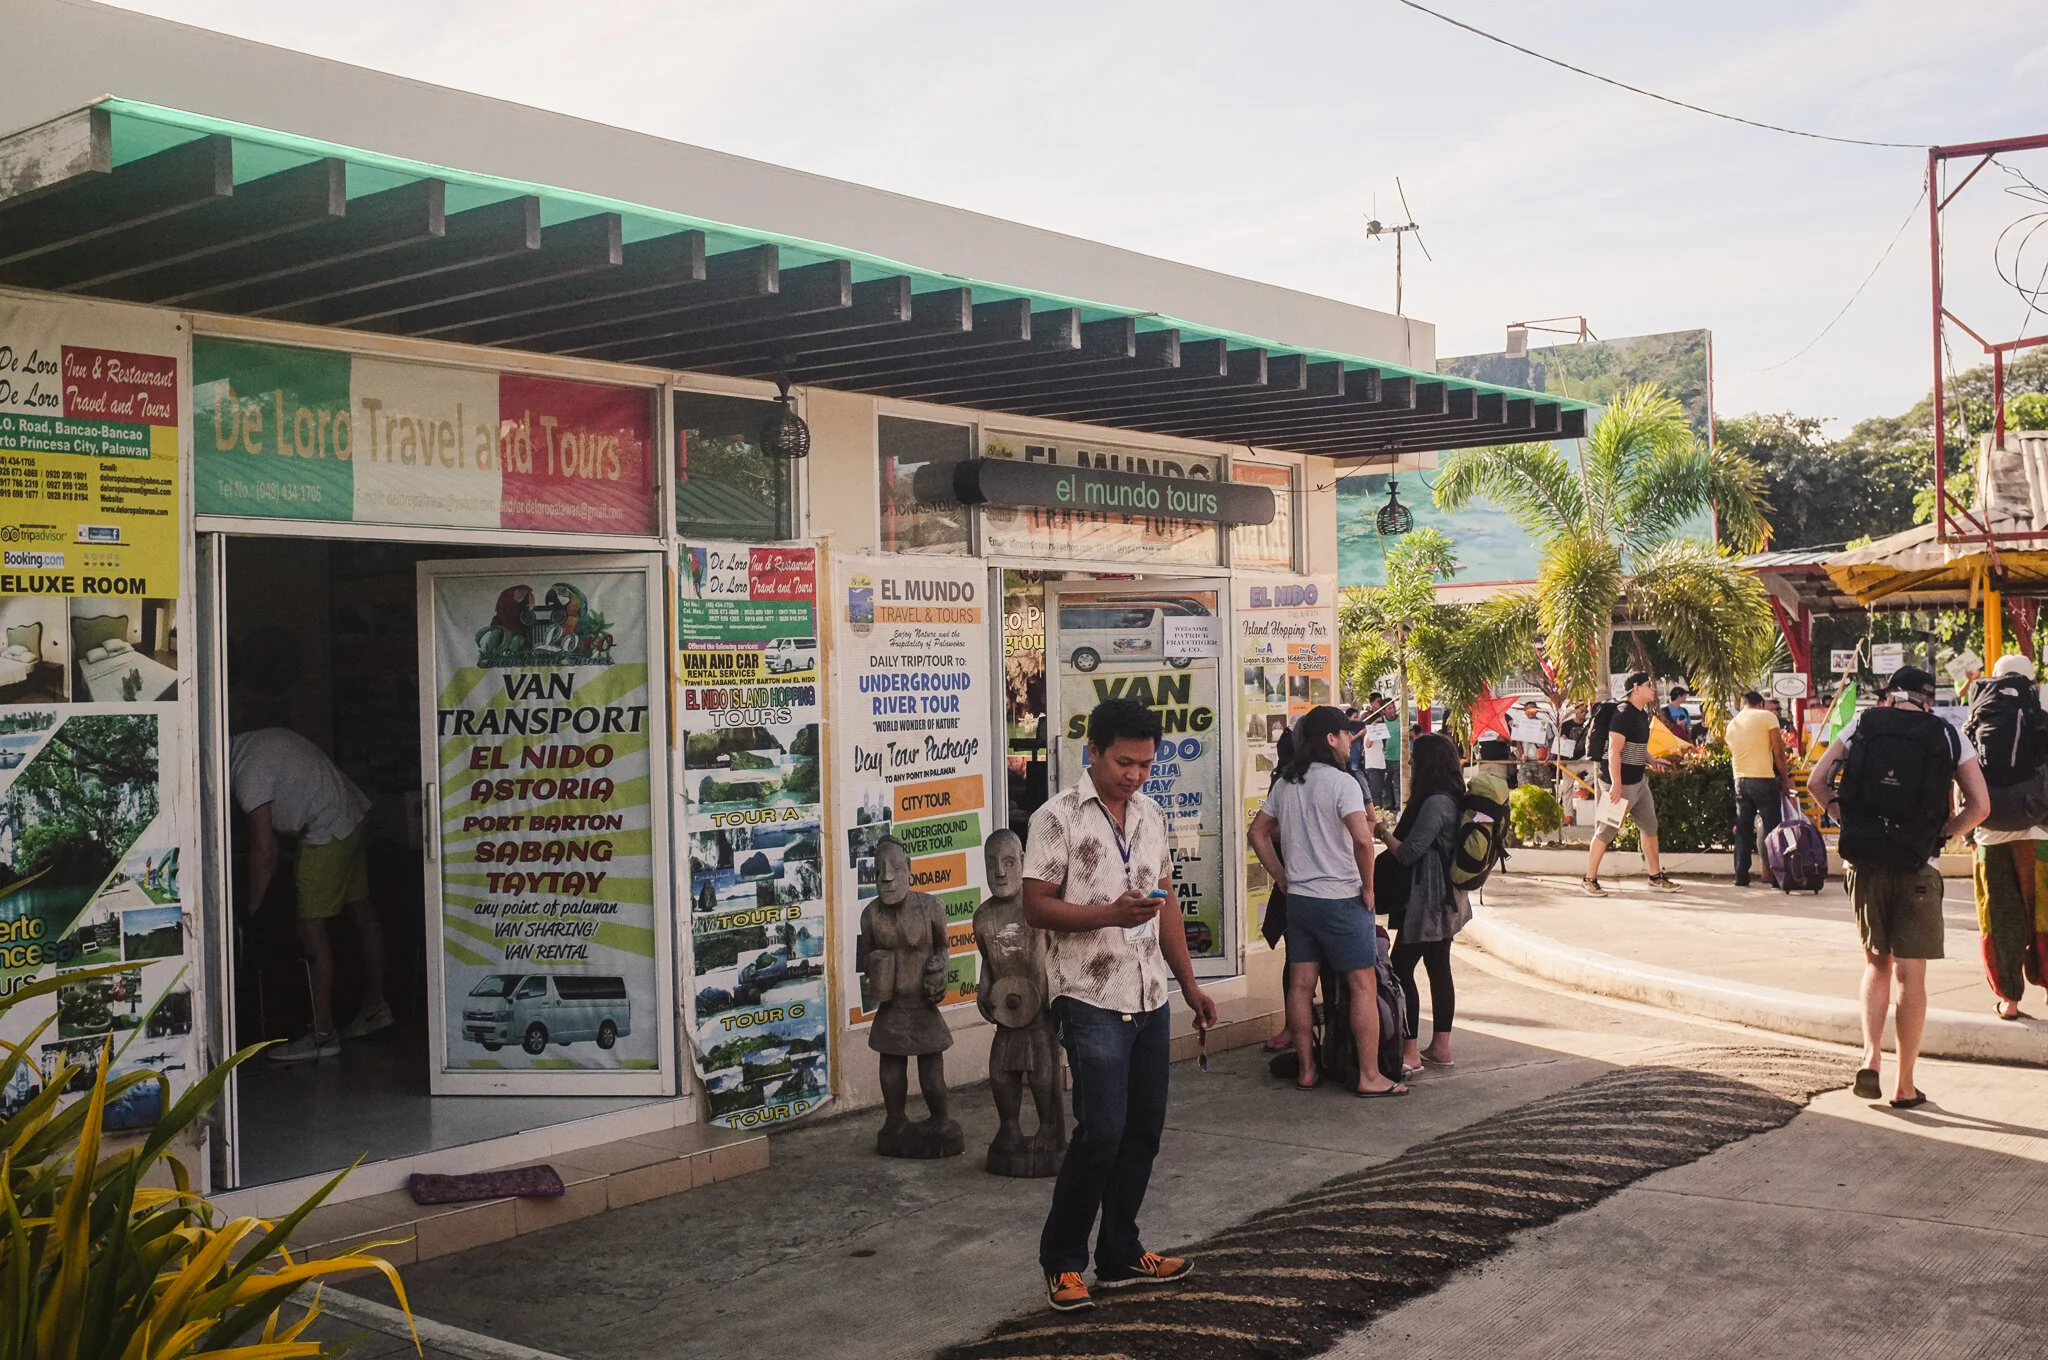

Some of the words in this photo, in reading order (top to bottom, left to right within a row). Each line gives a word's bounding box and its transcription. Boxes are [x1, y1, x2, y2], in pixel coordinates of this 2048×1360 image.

[0, 346, 19, 372] De
[22, 349, 58, 375] Loro
[65, 353, 87, 378] Inn
[92, 356, 102, 379] &
[107, 359, 173, 387] Restaurant
[0, 379, 19, 405] De
[23, 382, 59, 408] Loro
[66, 385, 107, 413] Travel
[110, 394, 134, 416] and
[138, 392, 171, 418] Tours
[19, 419, 52, 436] Road,
[55, 422, 143, 441] Bancao-Bancao
[214, 382, 263, 454] De
[275, 389, 353, 461] Loro
[362, 397, 465, 469] Travel
[476, 410, 533, 474] and
[540, 415, 621, 481] Tours
[20, 436, 71, 452] Princesa
[73, 440, 99, 456] City,
[102, 442, 149, 457] Palawan
[1056, 475, 1076, 501] el
[1085, 481, 1160, 510] mundo
[1166, 484, 1218, 514] tours
[21, 529, 64, 542] tripadvisor
[4, 551, 65, 568] Booking.com
[710, 552, 724, 570] De
[726, 553, 747, 570] Loro
[751, 554, 762, 571] Inn
[765, 554, 771, 570] &
[774, 556, 814, 572] Restaurant
[1, 575, 75, 593] ELUXE
[82, 576, 146, 594] ROOM
[710, 575, 724, 593] De
[726, 576, 747, 593] Loro
[751, 576, 775, 594] Travel
[777, 579, 791, 593] and
[793, 576, 813, 594] Tours
[881, 579, 901, 600] EL
[905, 580, 975, 602] MUNDO
[1250, 586, 1272, 608] EL
[1274, 584, 1318, 608] NIDO
[880, 607, 922, 622] TRAVEL
[924, 608, 933, 622] &
[936, 608, 974, 623] TOURS
[894, 629, 912, 639] Enjoy
[914, 628, 936, 638] Nature
[1243, 620, 1270, 636] Island
[1271, 621, 1306, 639] Hopping
[1308, 621, 1327, 635] Tour
[889, 638, 924, 649] Hospitality
[926, 641, 932, 649] of
[1266, 643, 1273, 653] A
[1310, 644, 1316, 653] C
[683, 654, 707, 669] VAN
[710, 654, 733, 669] AND
[736, 654, 759, 669] CAR
[870, 656, 899, 667] DAILY
[900, 656, 953, 667] TRIP/TOUR
[1244, 656, 1260, 665] Lagoon
[1308, 654, 1327, 662] Beaches
[684, 679, 703, 687] Travel
[687, 670, 717, 678] RENTAL
[720, 670, 756, 678] SERVICES
[859, 673, 971, 693] UNDERGROUND
[503, 673, 575, 701] VAN
[1091, 673, 1192, 706] VAN
[686, 690, 700, 710] EL
[701, 689, 728, 710] NIDO
[730, 687, 769, 709] ISLAND
[769, 685, 815, 708] HOPPING
[872, 695, 917, 715] RIVER
[920, 695, 960, 713] TOUR
[438, 706, 648, 736] TRANSPORT
[709, 708, 792, 726] TOURS
[899, 719, 926, 731] WONDER
[927, 719, 935, 730] OF
[469, 746, 509, 769] EL
[520, 744, 614, 769] NIDO
[854, 745, 883, 777] Day
[887, 741, 919, 767] Tour
[924, 735, 979, 764] Package
[884, 775, 892, 783] TO
[893, 772, 906, 783] ANY
[906, 770, 923, 780] POINT
[923, 769, 930, 778] IN
[930, 767, 956, 778] PALAWAN
[470, 777, 614, 804] ASTORIA
[901, 794, 924, 811] CITY
[925, 792, 951, 808] TOUR
[463, 816, 524, 832] PORT
[529, 815, 622, 832] BARTON
[711, 810, 776, 827] TOUR
[782, 807, 799, 820] A
[901, 820, 968, 841] UNDERGROUND
[475, 841, 613, 866] SABANG
[902, 839, 928, 854] RIVER
[929, 837, 953, 850] TOUR
[486, 872, 606, 897] TAYTAY
[935, 869, 951, 883] BAY
[474, 902, 498, 917] any
[501, 900, 538, 917] point
[543, 900, 556, 916] of
[560, 900, 618, 917] palawan
[718, 908, 780, 929] TOUR
[787, 906, 801, 920] B
[494, 923, 521, 938] VAN
[524, 922, 599, 937] SHARING!
[504, 944, 530, 960] VAN
[536, 944, 588, 960] RENTAL
[720, 1009, 784, 1031] TOUR
[789, 1004, 805, 1020] C
[726, 1104, 789, 1129] TOUR
[794, 1100, 811, 1115] D
